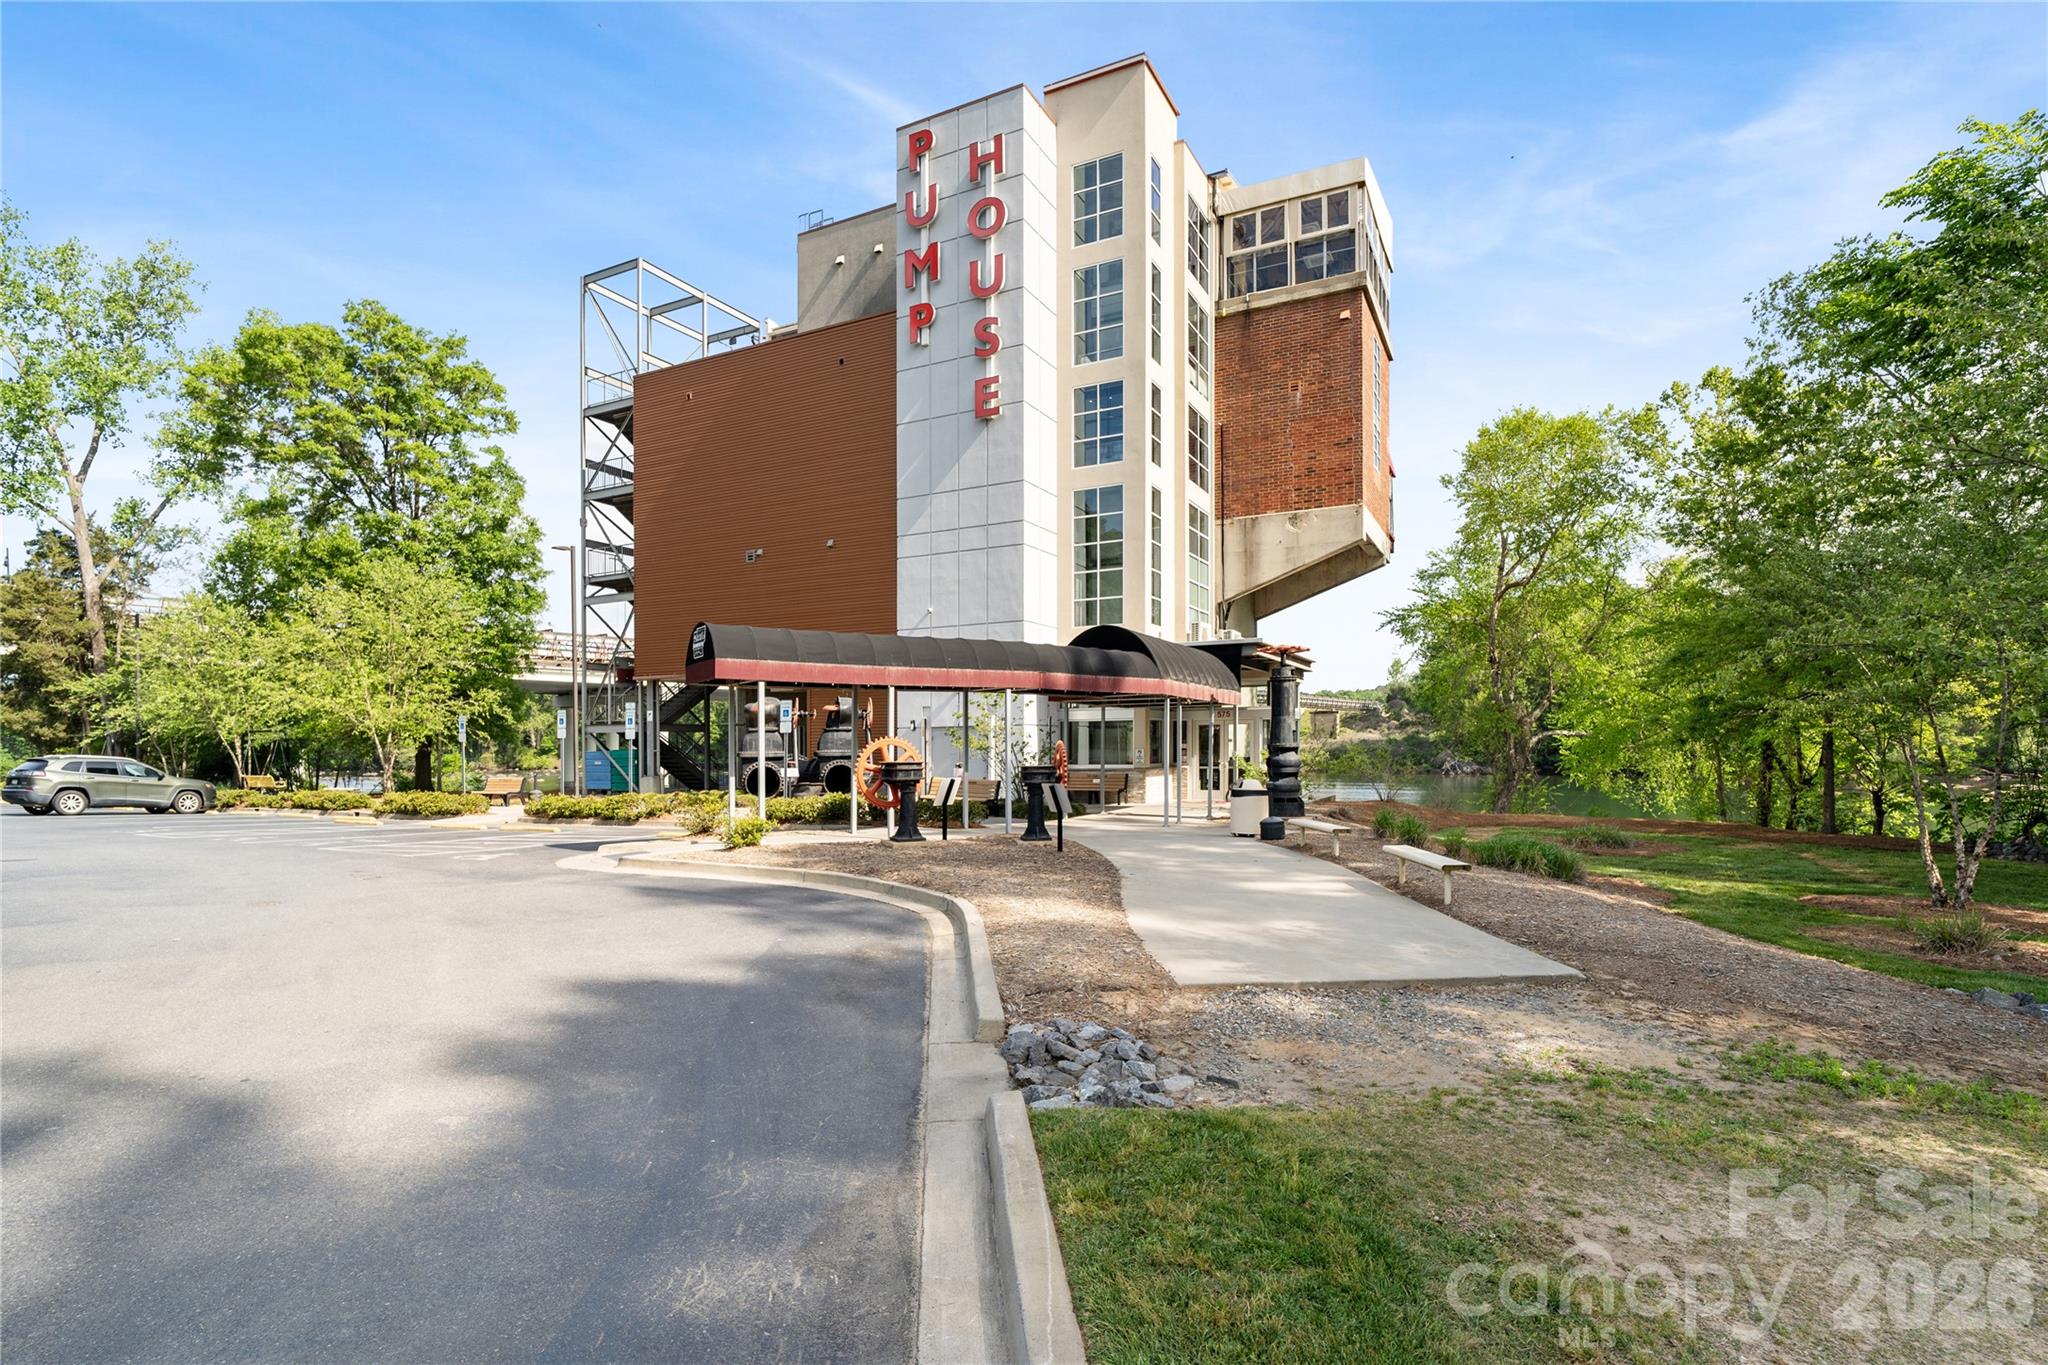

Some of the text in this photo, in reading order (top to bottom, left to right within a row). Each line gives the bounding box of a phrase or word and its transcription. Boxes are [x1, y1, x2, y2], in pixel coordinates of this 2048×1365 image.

[905, 129, 940, 345] PUMP
[967, 133, 1007, 419] HOUSE
[1216, 710, 1231, 719] 575
